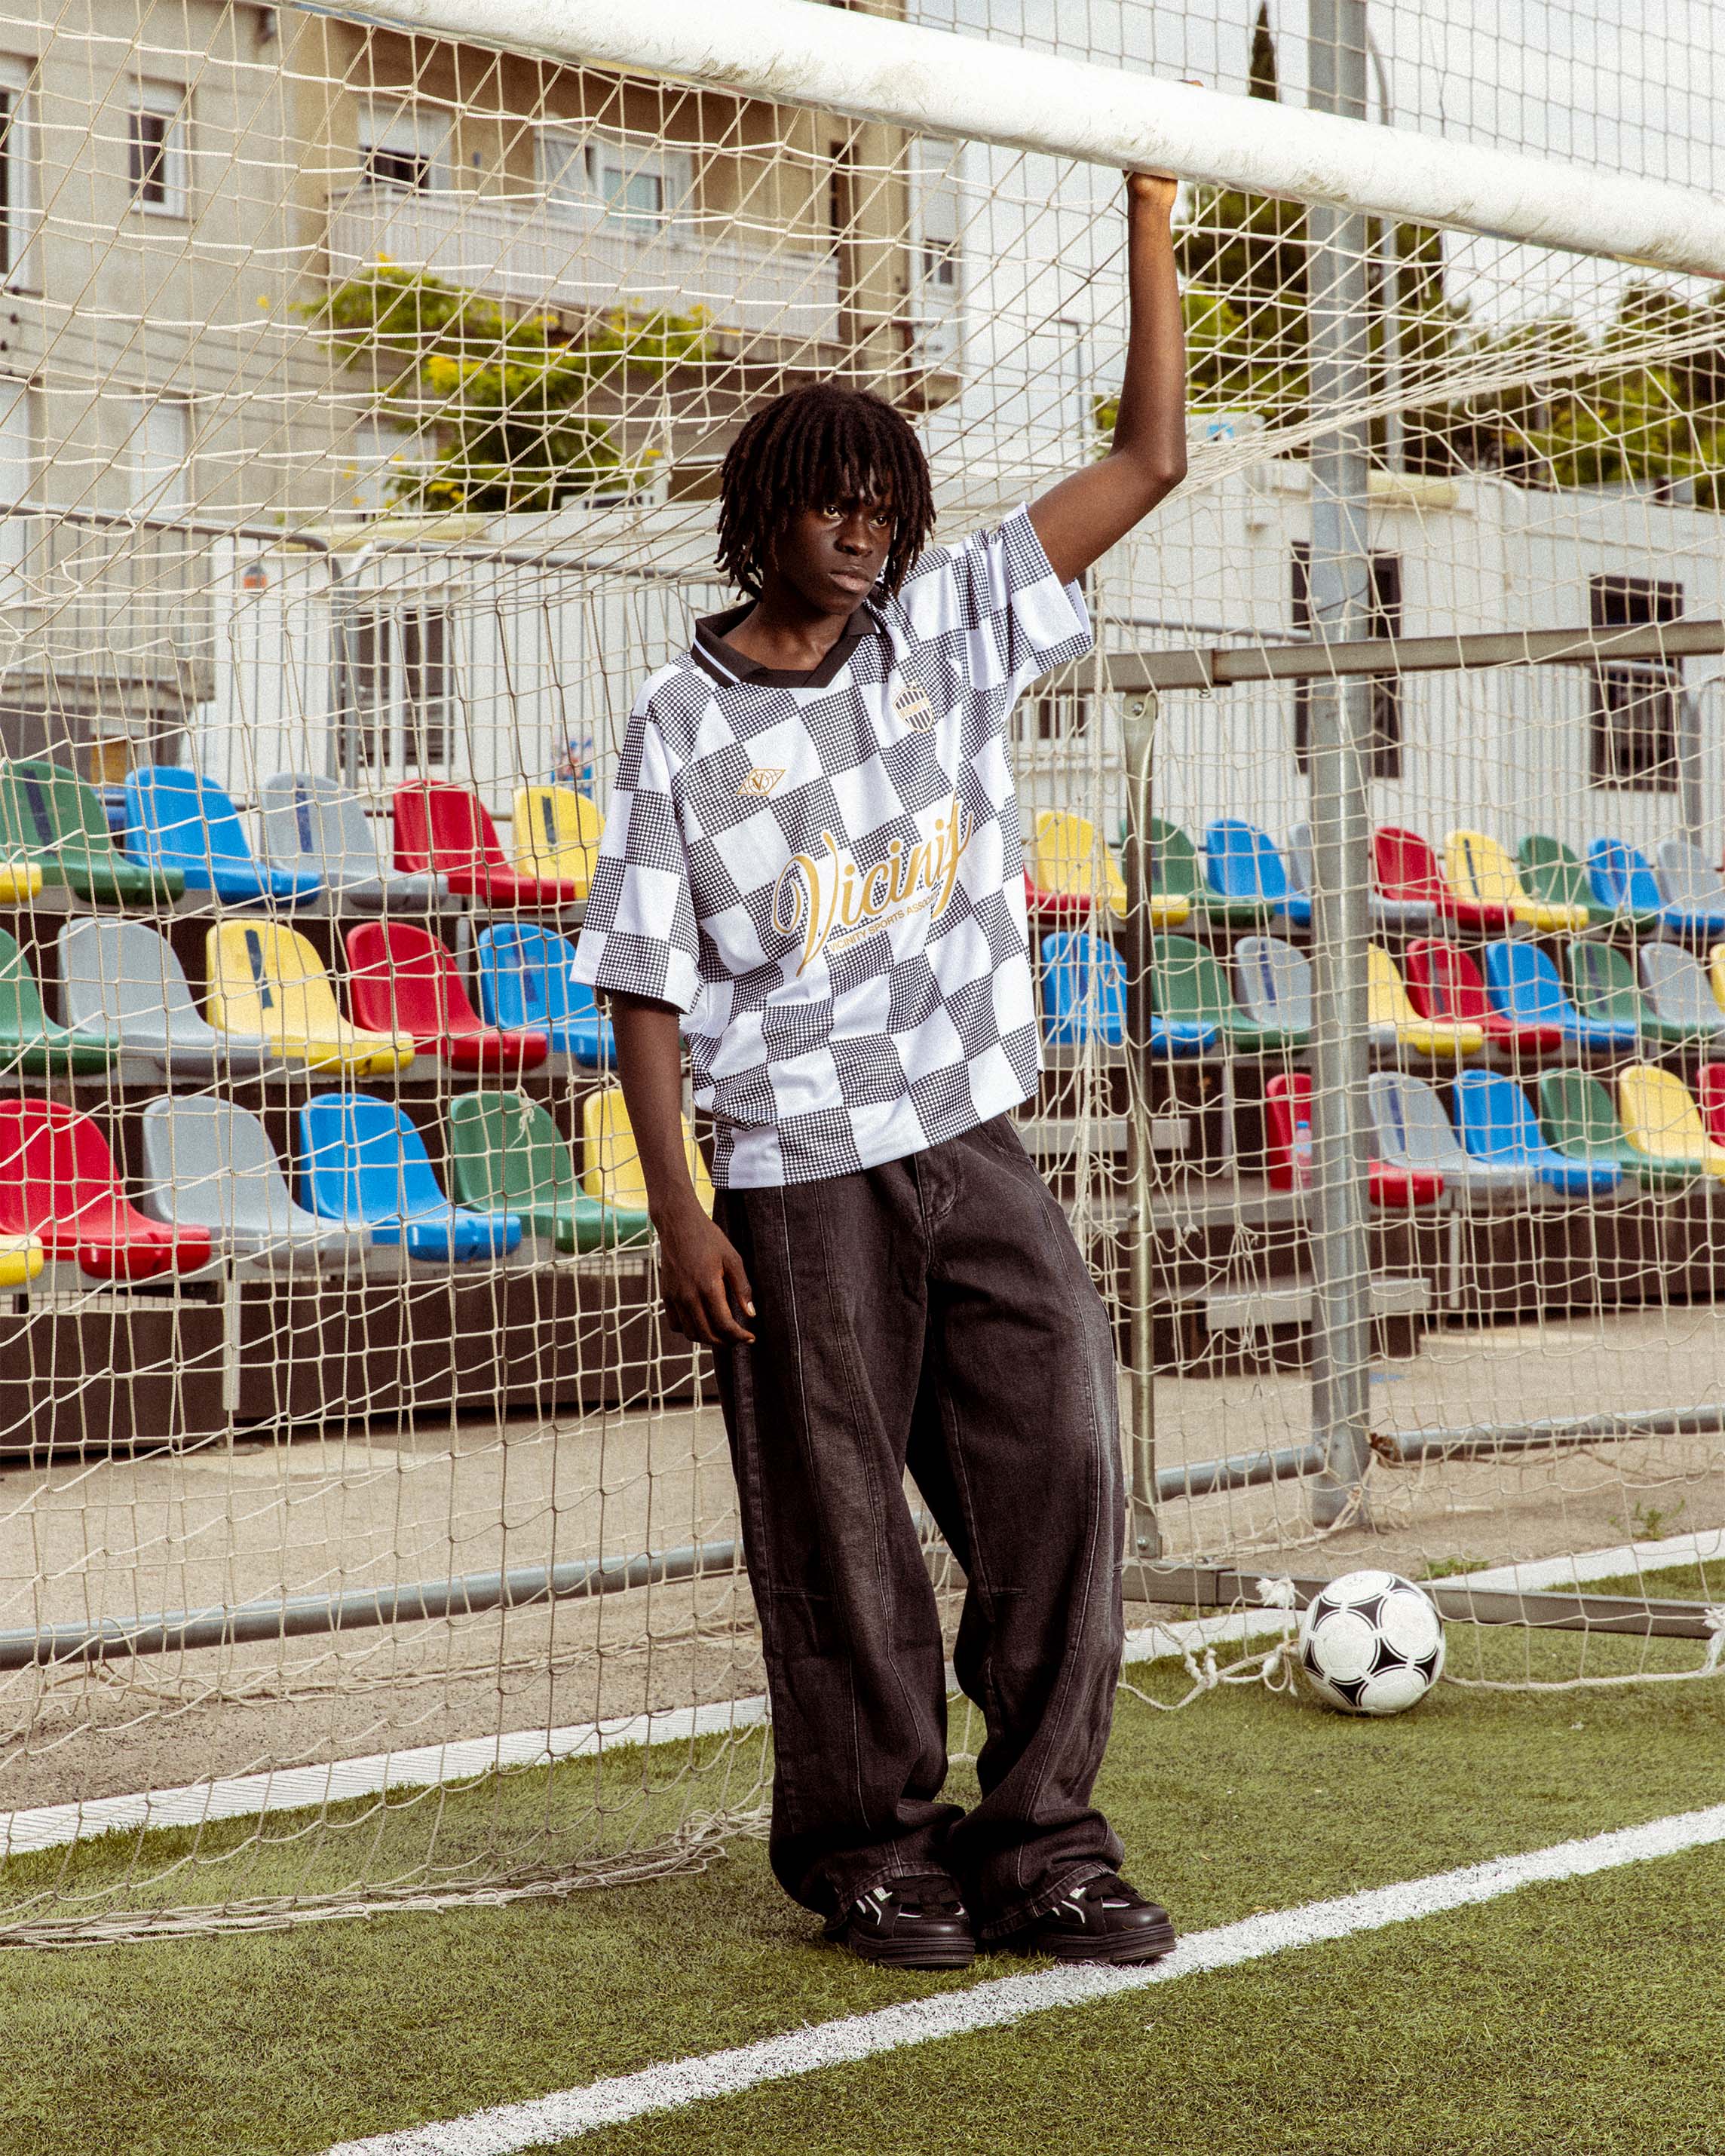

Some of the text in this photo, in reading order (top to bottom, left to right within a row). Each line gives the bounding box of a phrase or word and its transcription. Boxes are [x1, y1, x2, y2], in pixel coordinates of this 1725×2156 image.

[774, 789, 973, 978] Viciniy
[829, 929, 867, 953] VICINITY
[869, 909, 905, 935] SPORTS
